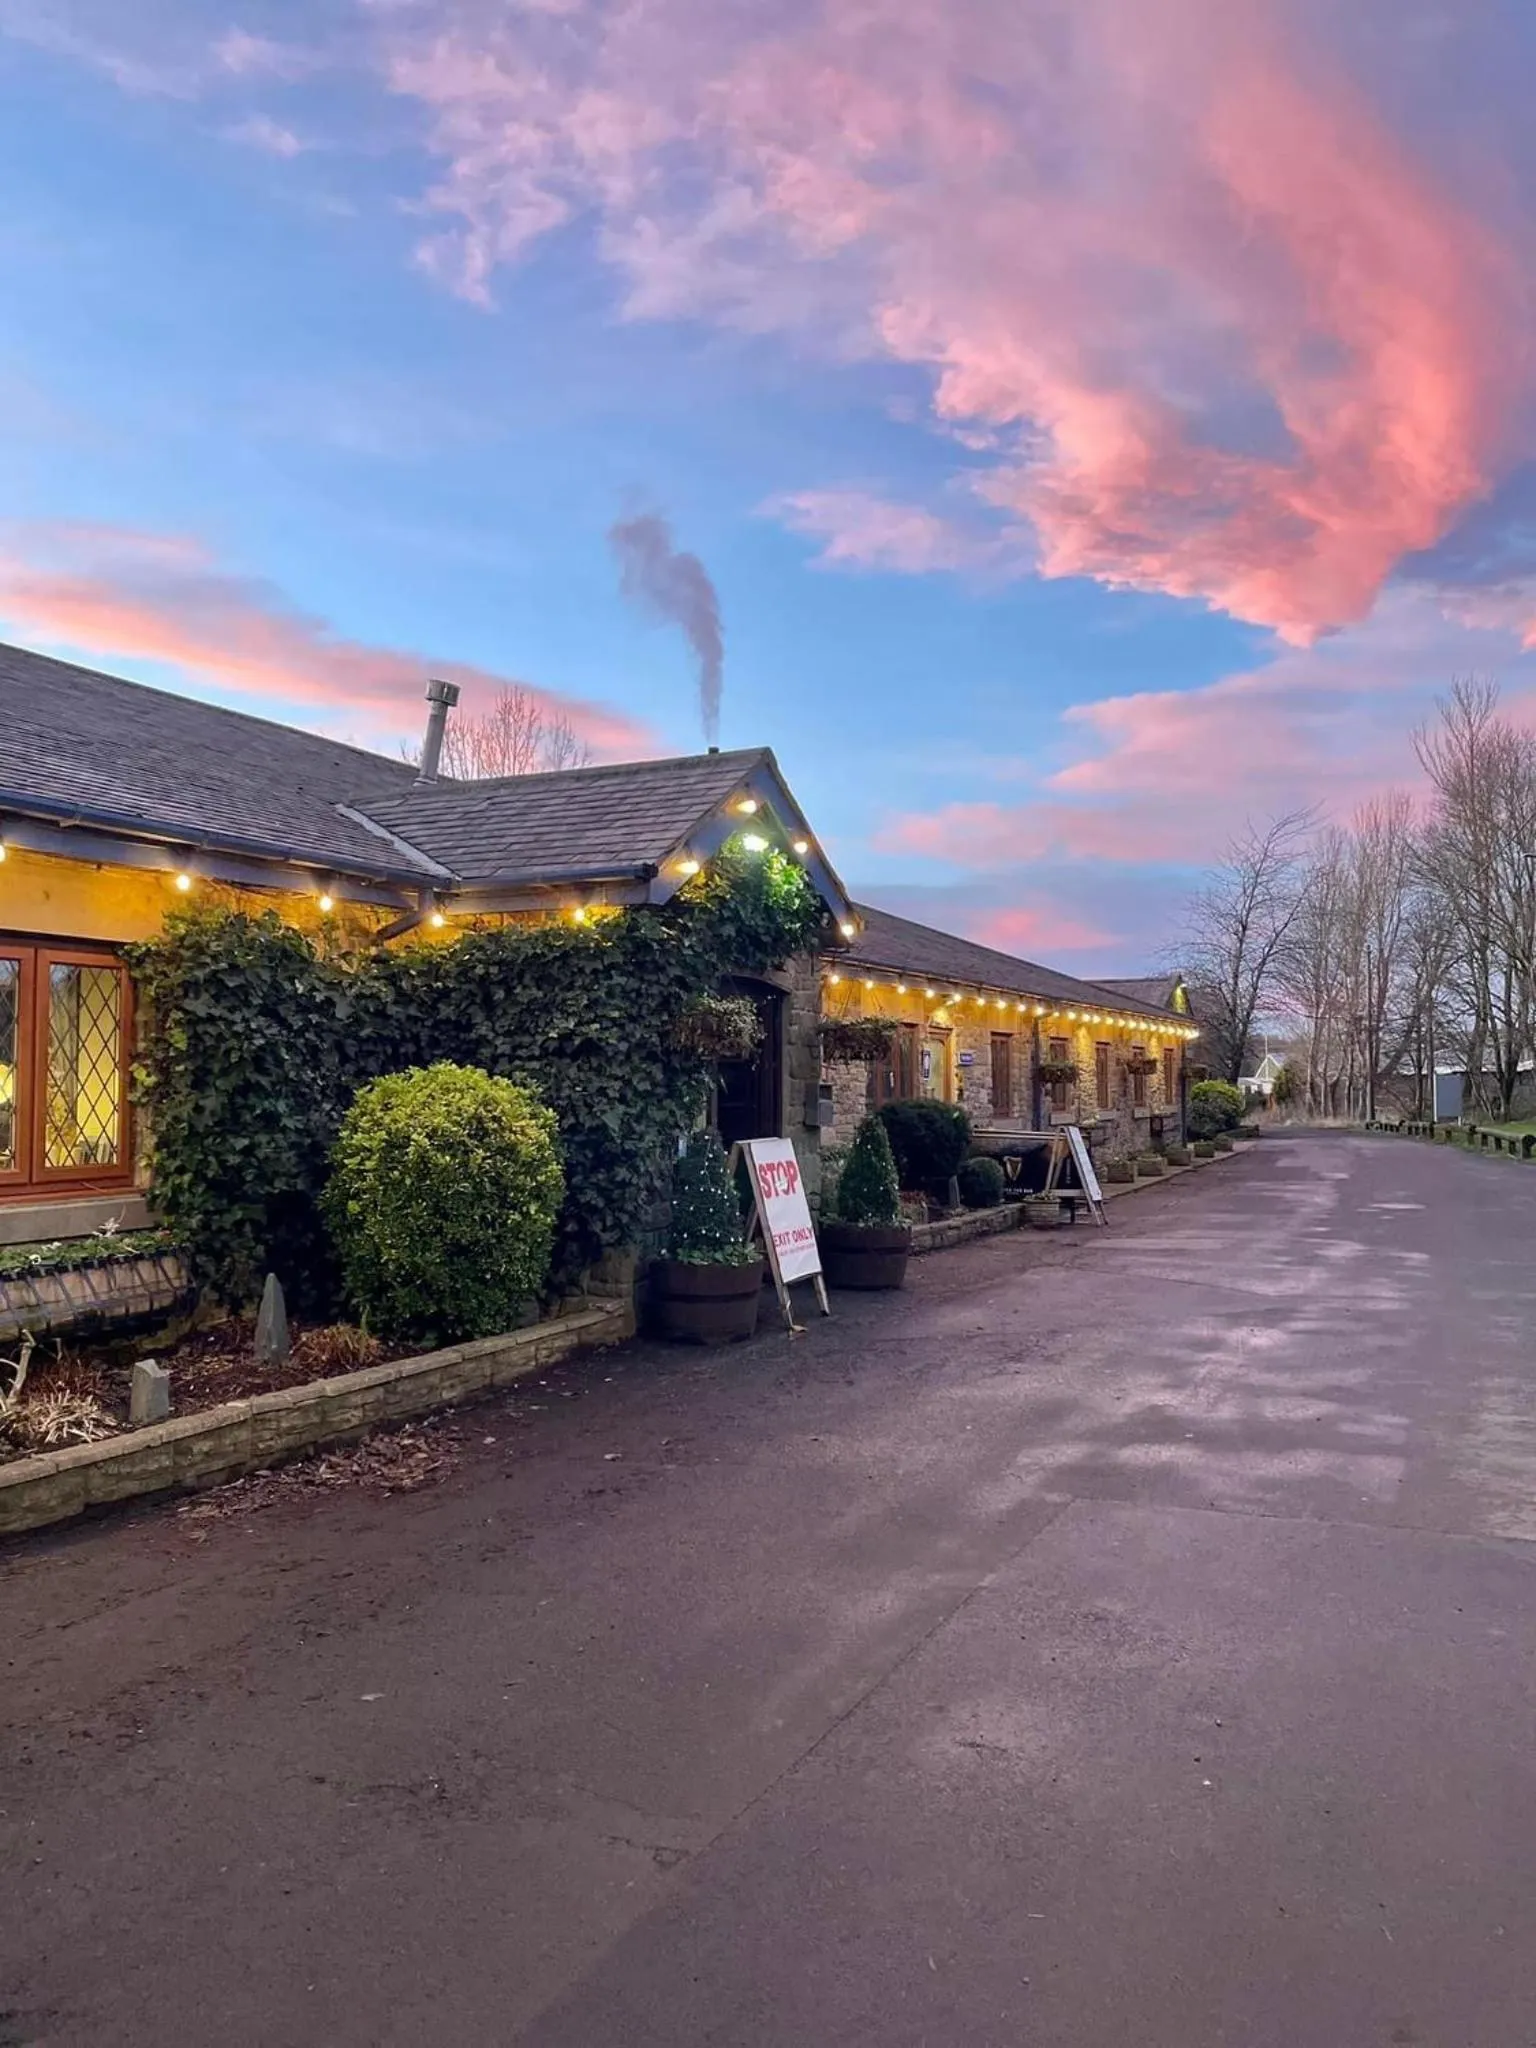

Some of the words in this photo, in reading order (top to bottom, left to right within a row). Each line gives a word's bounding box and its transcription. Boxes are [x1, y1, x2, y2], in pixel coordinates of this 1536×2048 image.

[758, 1160, 798, 1198] STOP
[773, 1231, 791, 1247] EXIT
[792, 1227, 814, 1243] ONLY
